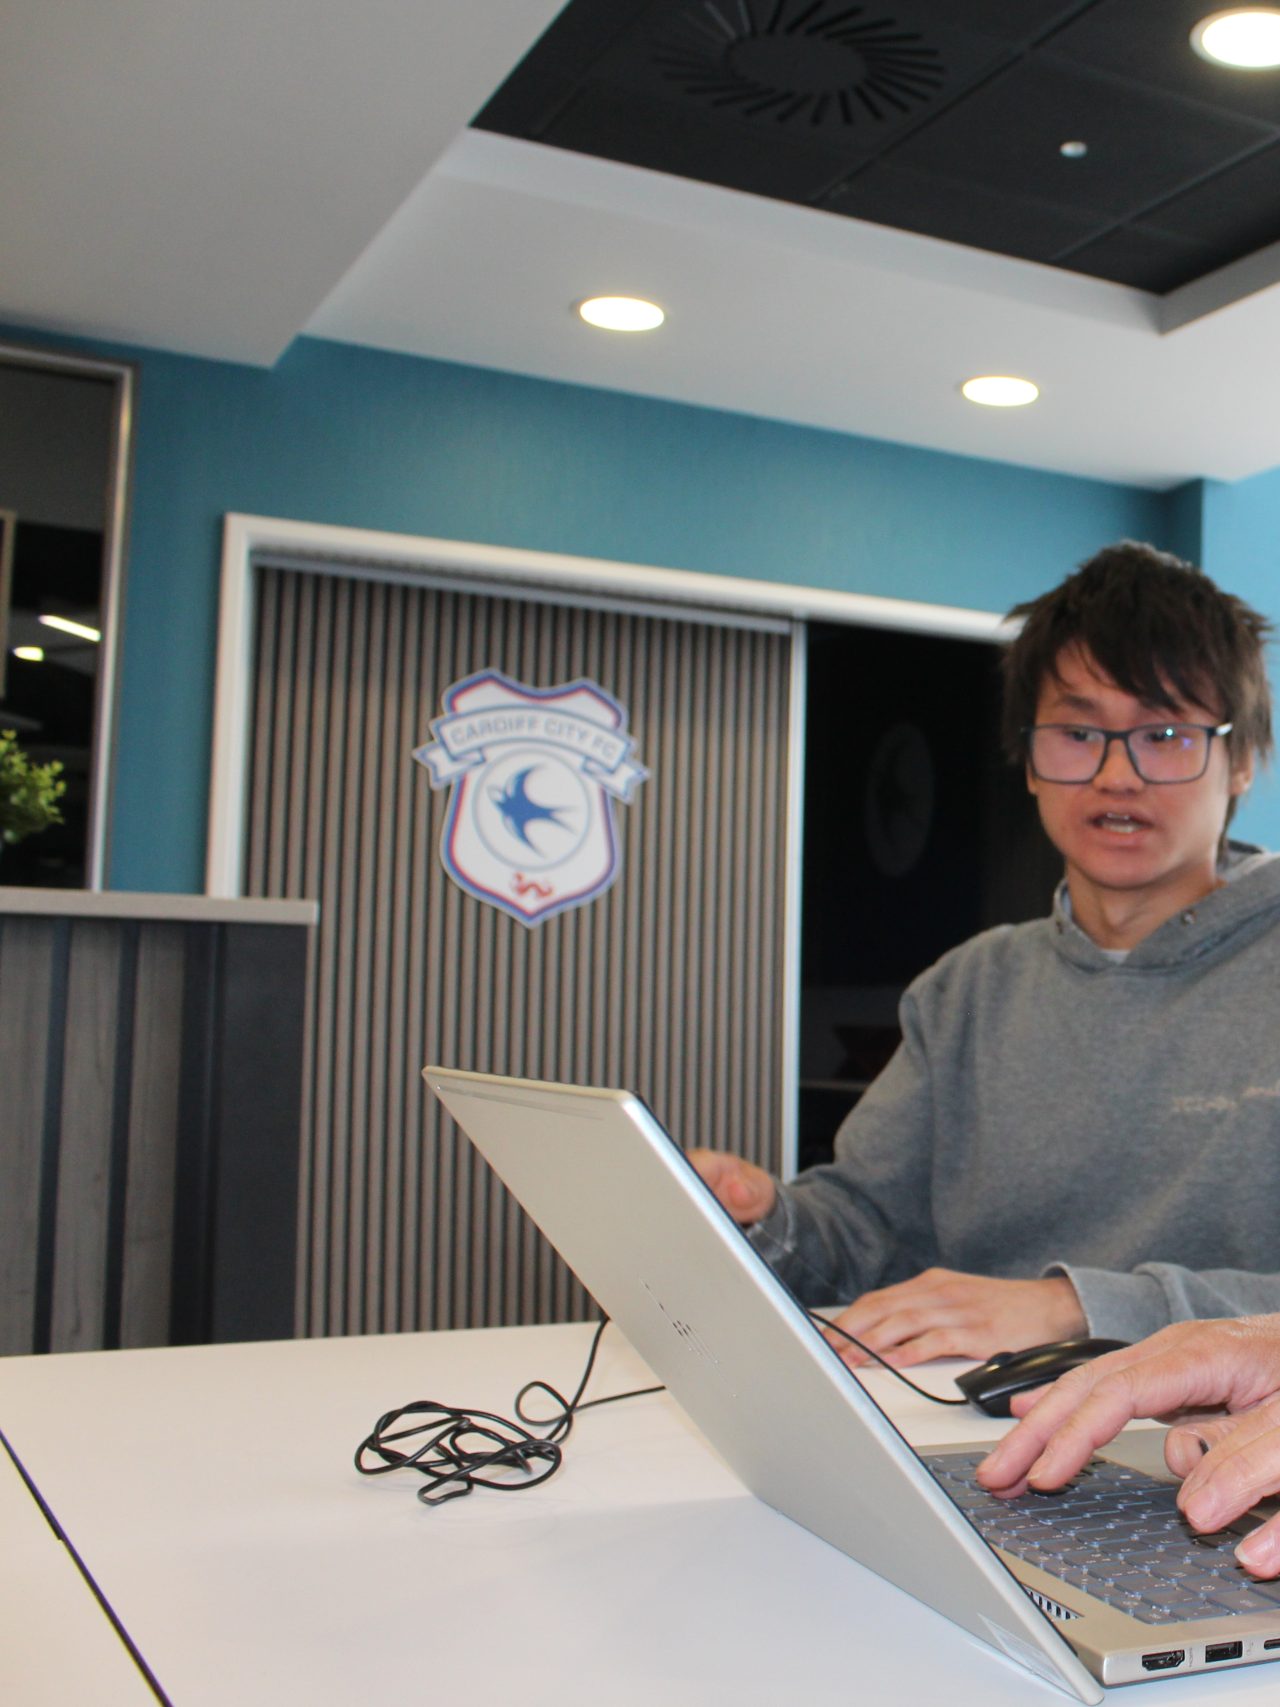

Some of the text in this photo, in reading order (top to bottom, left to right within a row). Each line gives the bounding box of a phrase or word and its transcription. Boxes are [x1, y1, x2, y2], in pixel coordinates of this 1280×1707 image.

[451, 716, 618, 758] CARDIFF CITY FC
